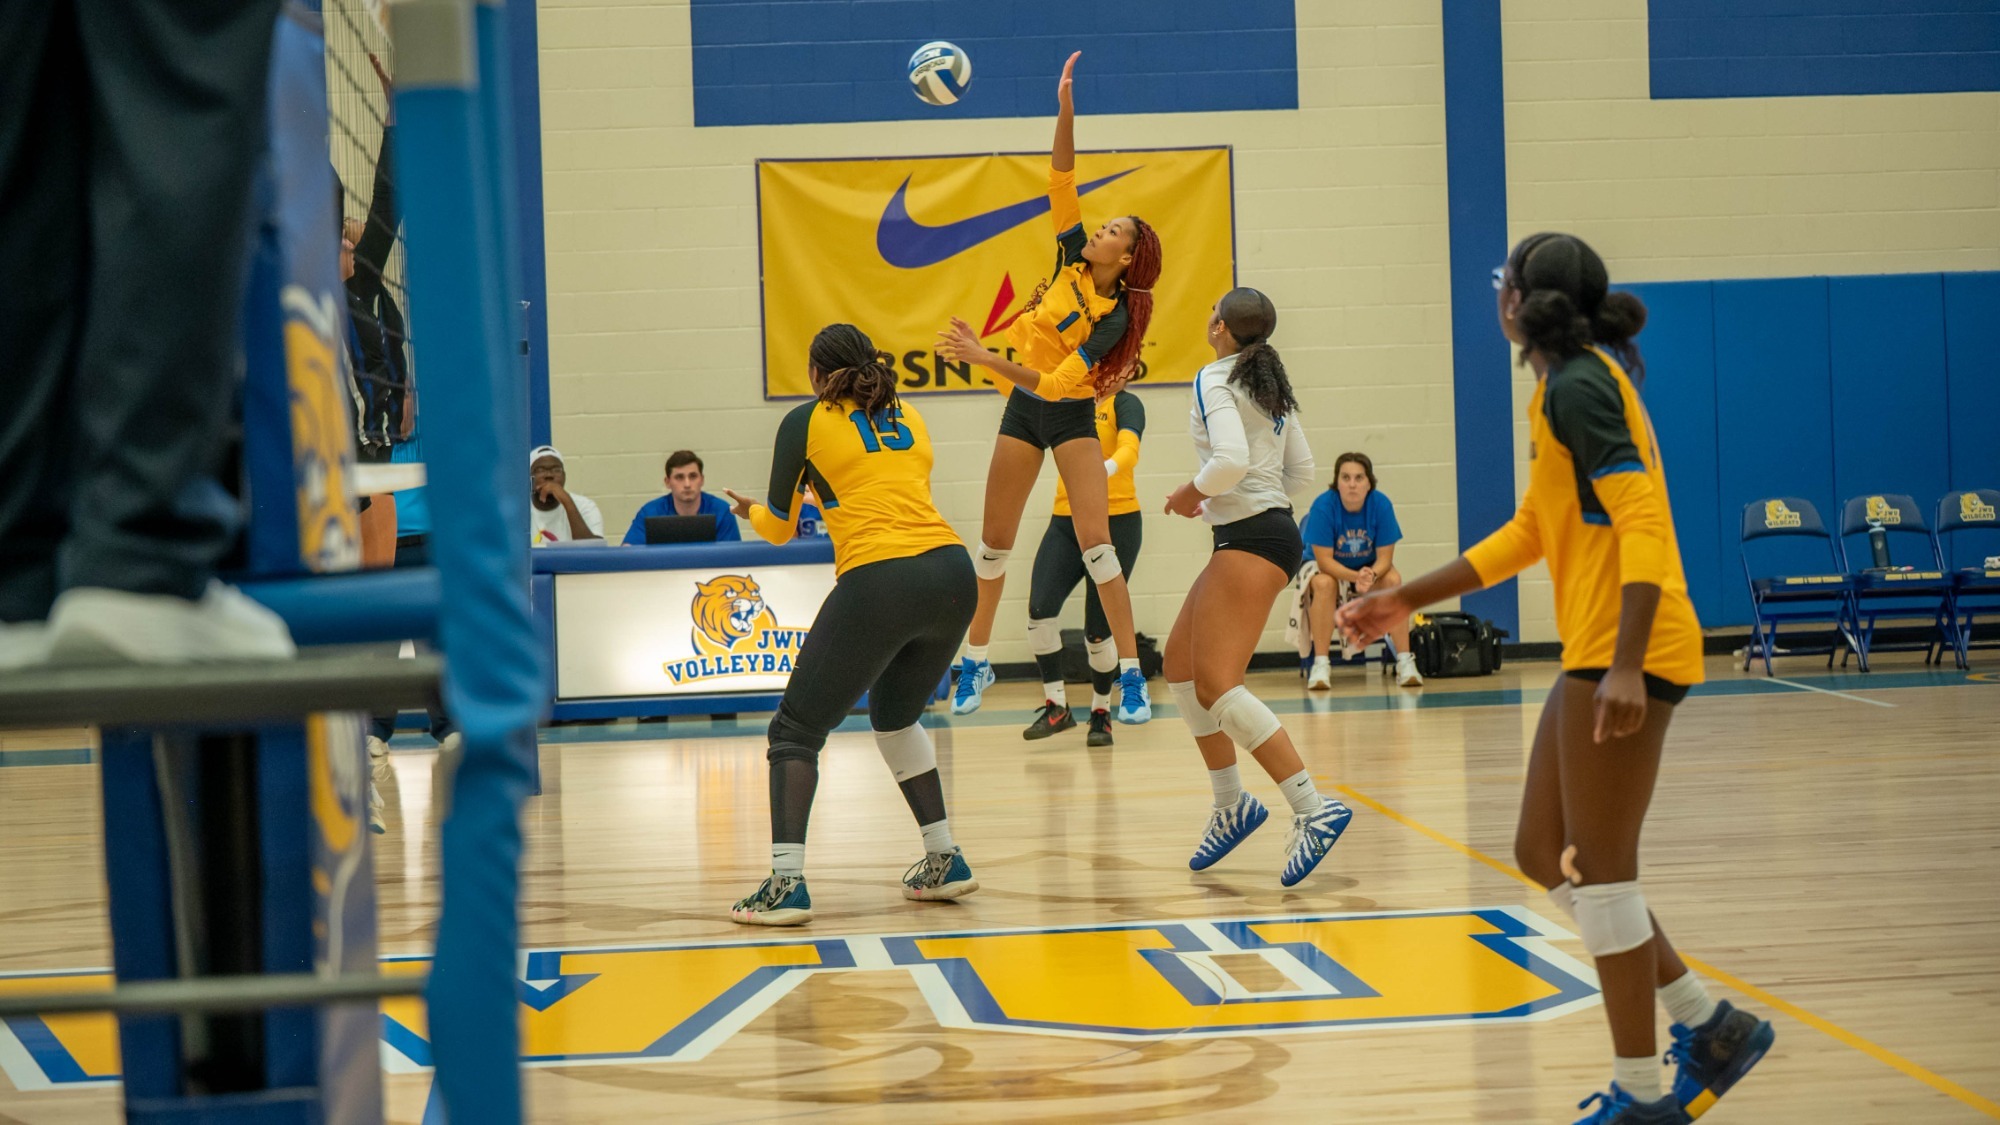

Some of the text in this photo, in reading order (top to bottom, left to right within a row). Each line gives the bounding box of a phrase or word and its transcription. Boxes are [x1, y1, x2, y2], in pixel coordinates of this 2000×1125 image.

[1056, 311, 1081, 334] 1
[848, 407, 915, 453] 15
[757, 630, 809, 649] JWU
[667, 654, 798, 682] VOLLEYBA
